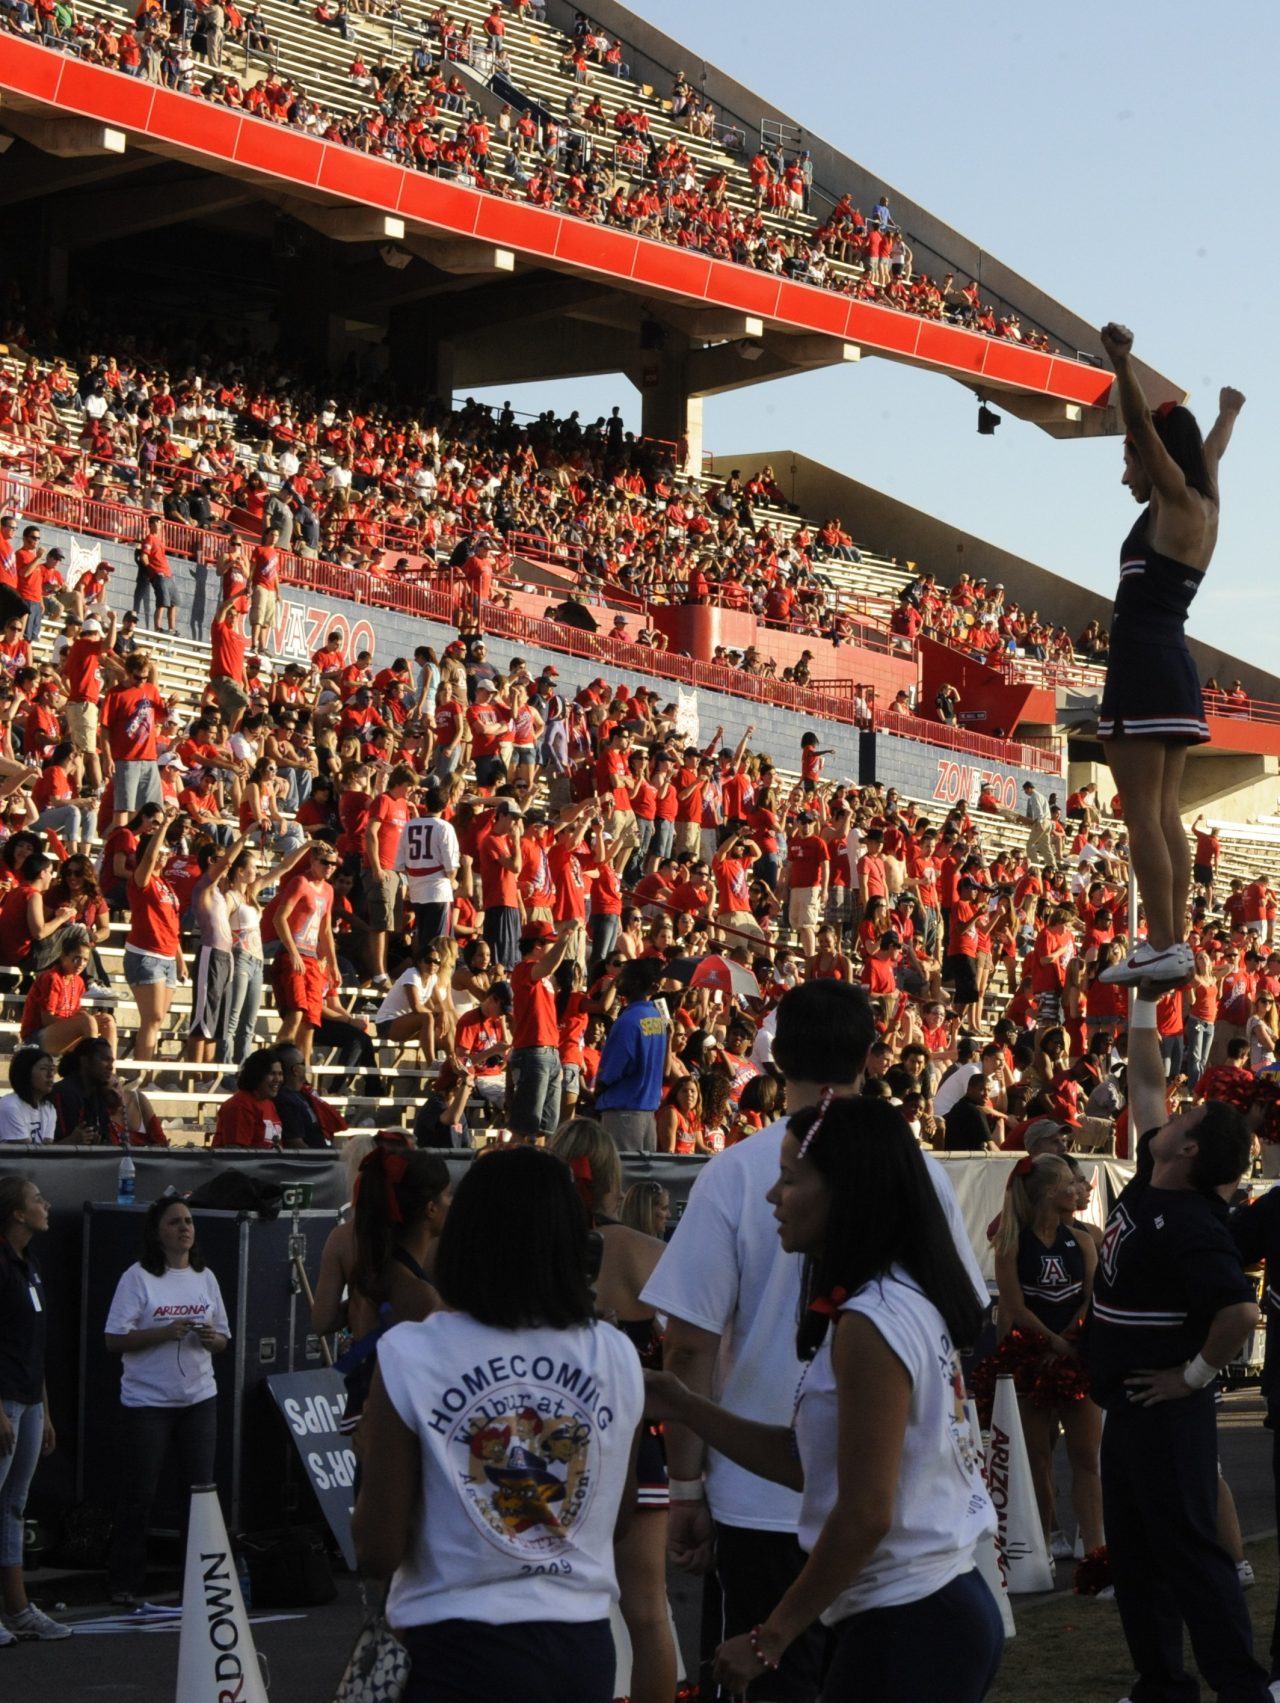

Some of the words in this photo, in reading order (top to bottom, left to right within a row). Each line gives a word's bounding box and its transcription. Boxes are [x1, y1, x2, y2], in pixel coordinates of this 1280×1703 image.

[408, 825, 434, 860] 51
[1038, 1255, 1072, 1287] A
[153, 1304, 207, 1317] ARIZONA
[537, 1396, 566, 1420] at
